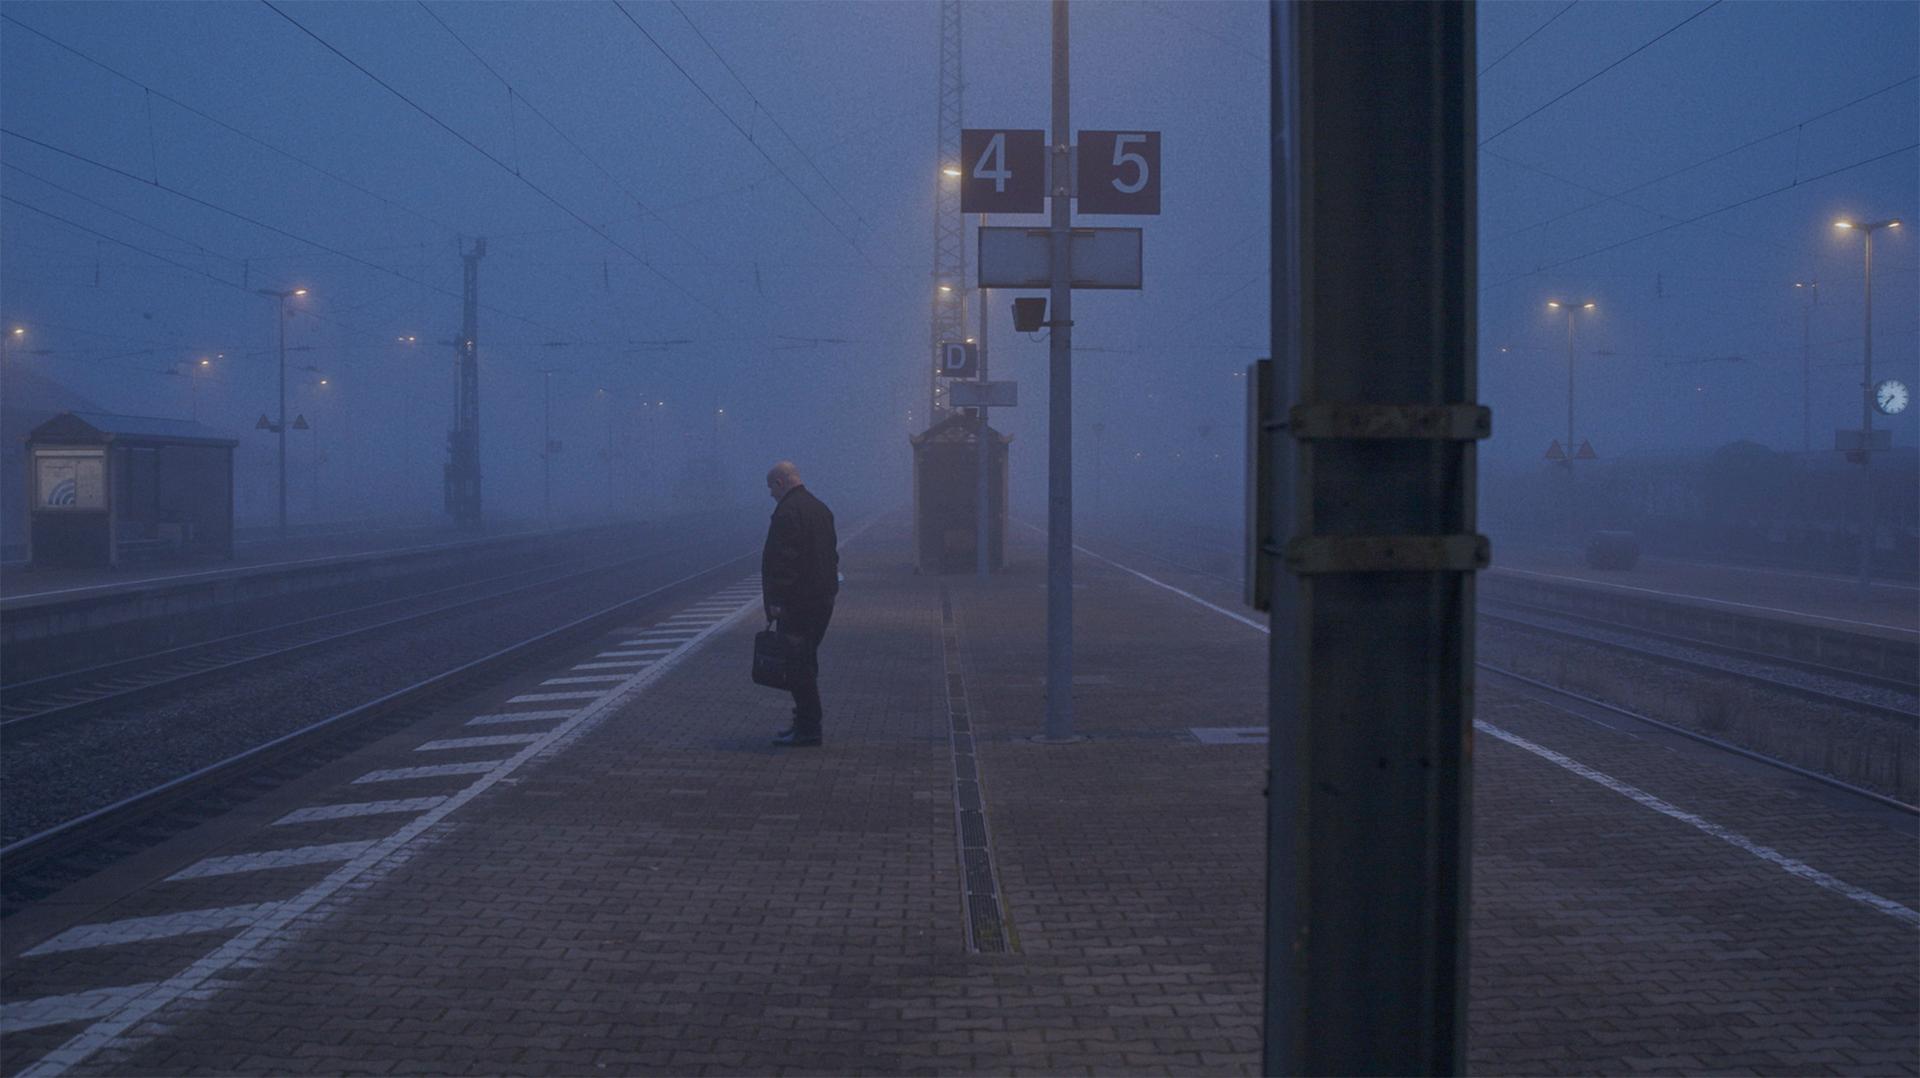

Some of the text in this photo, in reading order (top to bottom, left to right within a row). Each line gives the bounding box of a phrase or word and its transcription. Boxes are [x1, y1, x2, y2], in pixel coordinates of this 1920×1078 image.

[973, 133, 1012, 193] 4
[1111, 134, 1149, 194] 5
[946, 344, 966, 369] D
